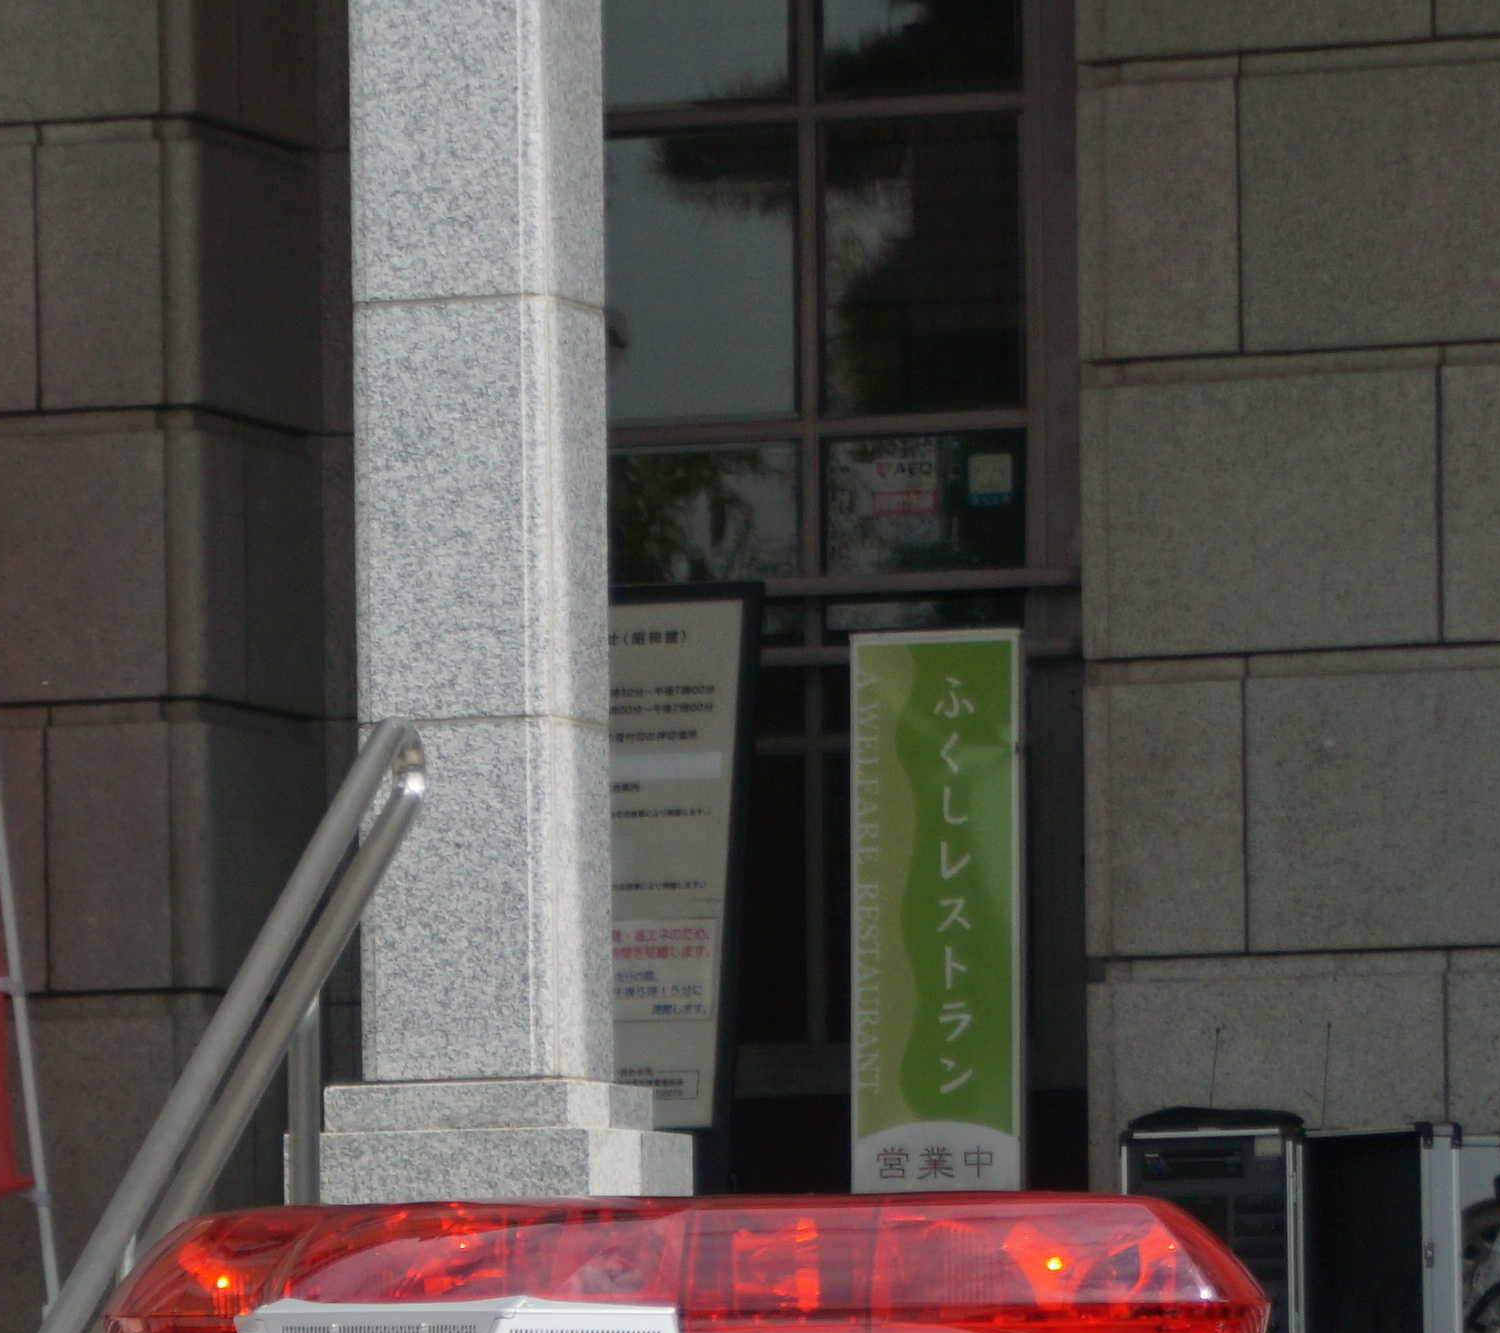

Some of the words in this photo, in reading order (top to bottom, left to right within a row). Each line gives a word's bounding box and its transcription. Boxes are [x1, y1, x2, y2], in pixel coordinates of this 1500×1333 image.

[856, 703, 880, 864] WELFARE
[934, 677, 974, 1095] ふくしレストラン
[856, 883, 880, 1095] RESTAURANT
[876, 1146, 994, 1181] 営業中
